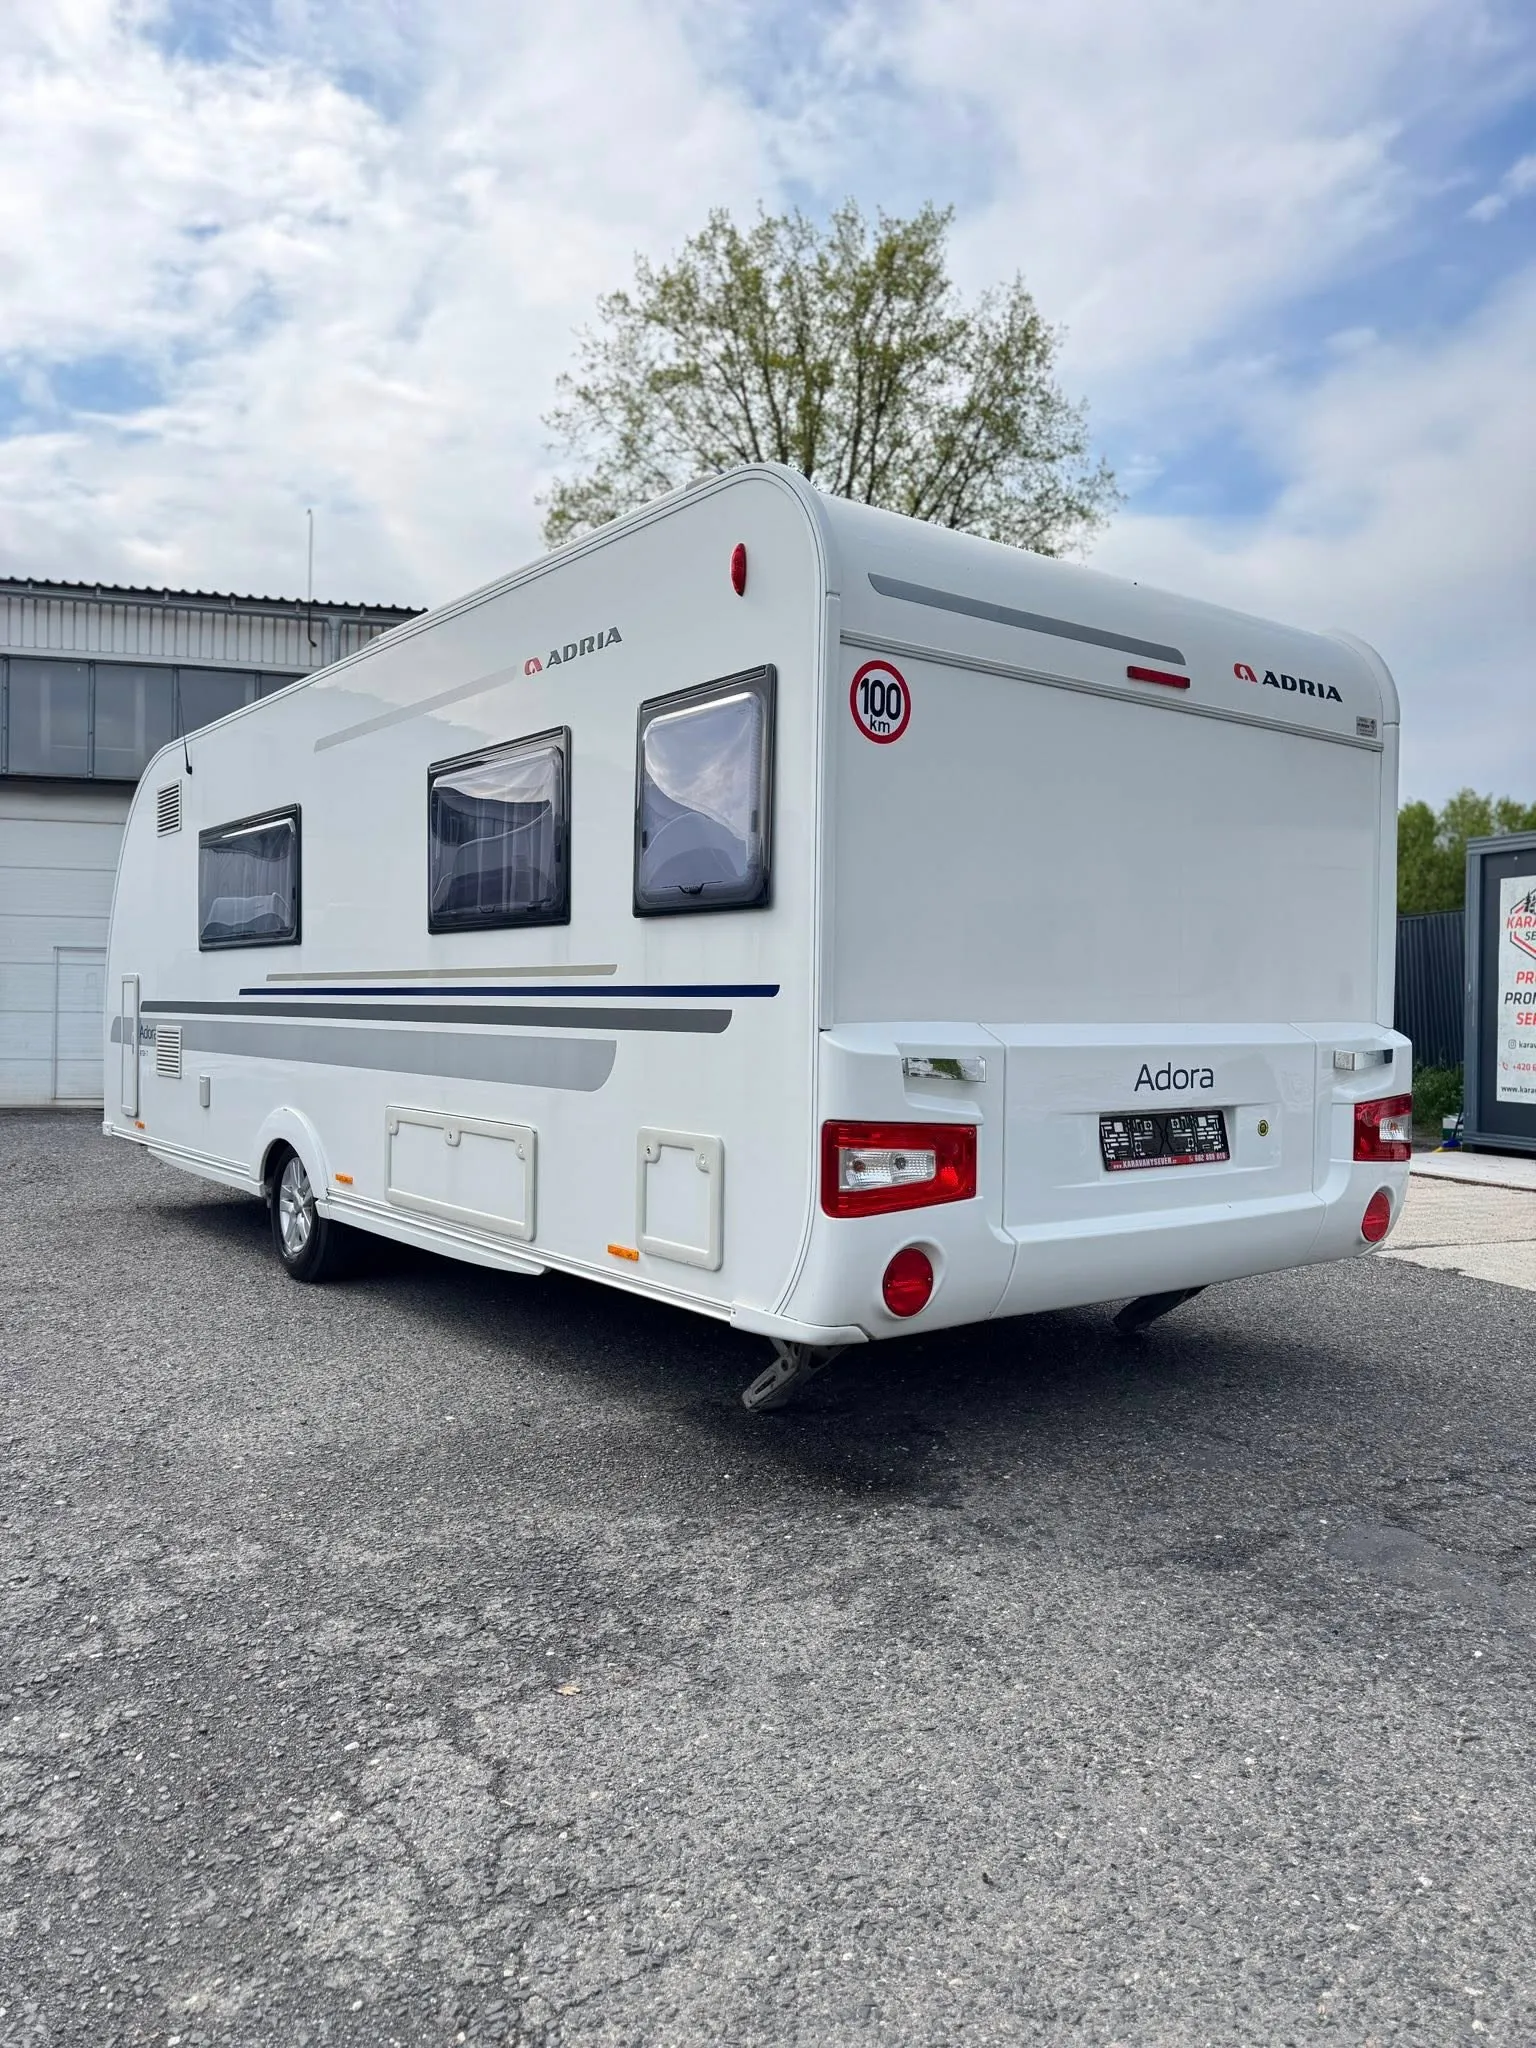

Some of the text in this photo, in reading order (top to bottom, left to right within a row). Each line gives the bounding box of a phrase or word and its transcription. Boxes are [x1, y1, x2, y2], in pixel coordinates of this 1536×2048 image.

[546, 627, 622, 668] ADRIA
[860, 678, 901, 720] 100
[1262, 670, 1343, 703] ADRIA
[869, 714, 890, 733] km
[1516, 971, 1536, 984] PR
[1134, 1062, 1214, 1092] Adora
[1501, 1086, 1536, 1094] www.kara
